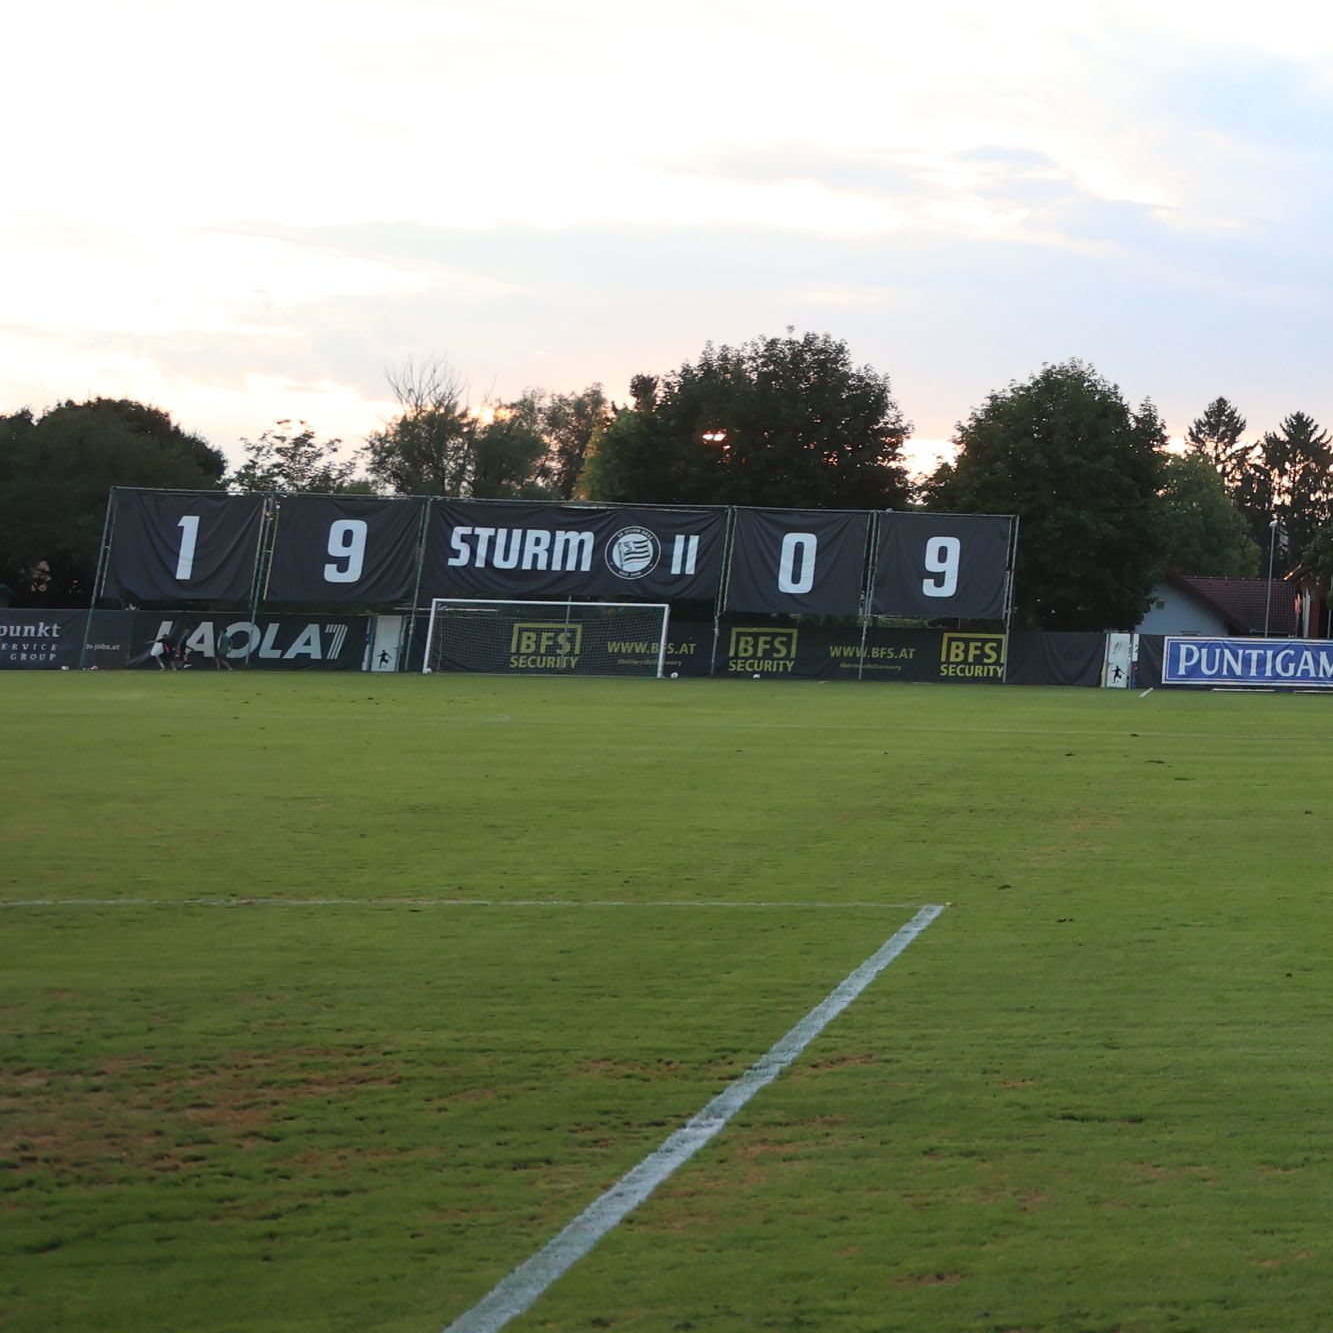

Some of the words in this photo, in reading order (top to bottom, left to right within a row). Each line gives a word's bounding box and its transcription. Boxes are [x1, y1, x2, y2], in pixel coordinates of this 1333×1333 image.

[175, 515, 200, 580] 1
[323, 519, 368, 583] 9
[447, 526, 595, 572] STURM
[778, 532, 818, 594] 0
[922, 536, 961, 598] 9
[0, 622, 61, 640] punkt
[0, 643, 58, 651] ERVICE
[519, 631, 572, 654] BFS
[607, 641, 697, 655] WWW.BS.AT
[738, 635, 787, 658] BFS
[10, 653, 57, 662] GROUP
[829, 646, 916, 660] WWW.BFS.AT
[950, 641, 998, 664] BFS
[509, 655, 580, 669] SECURITY
[728, 659, 795, 673] SECURITY
[939, 664, 1005, 678] SECURITY
